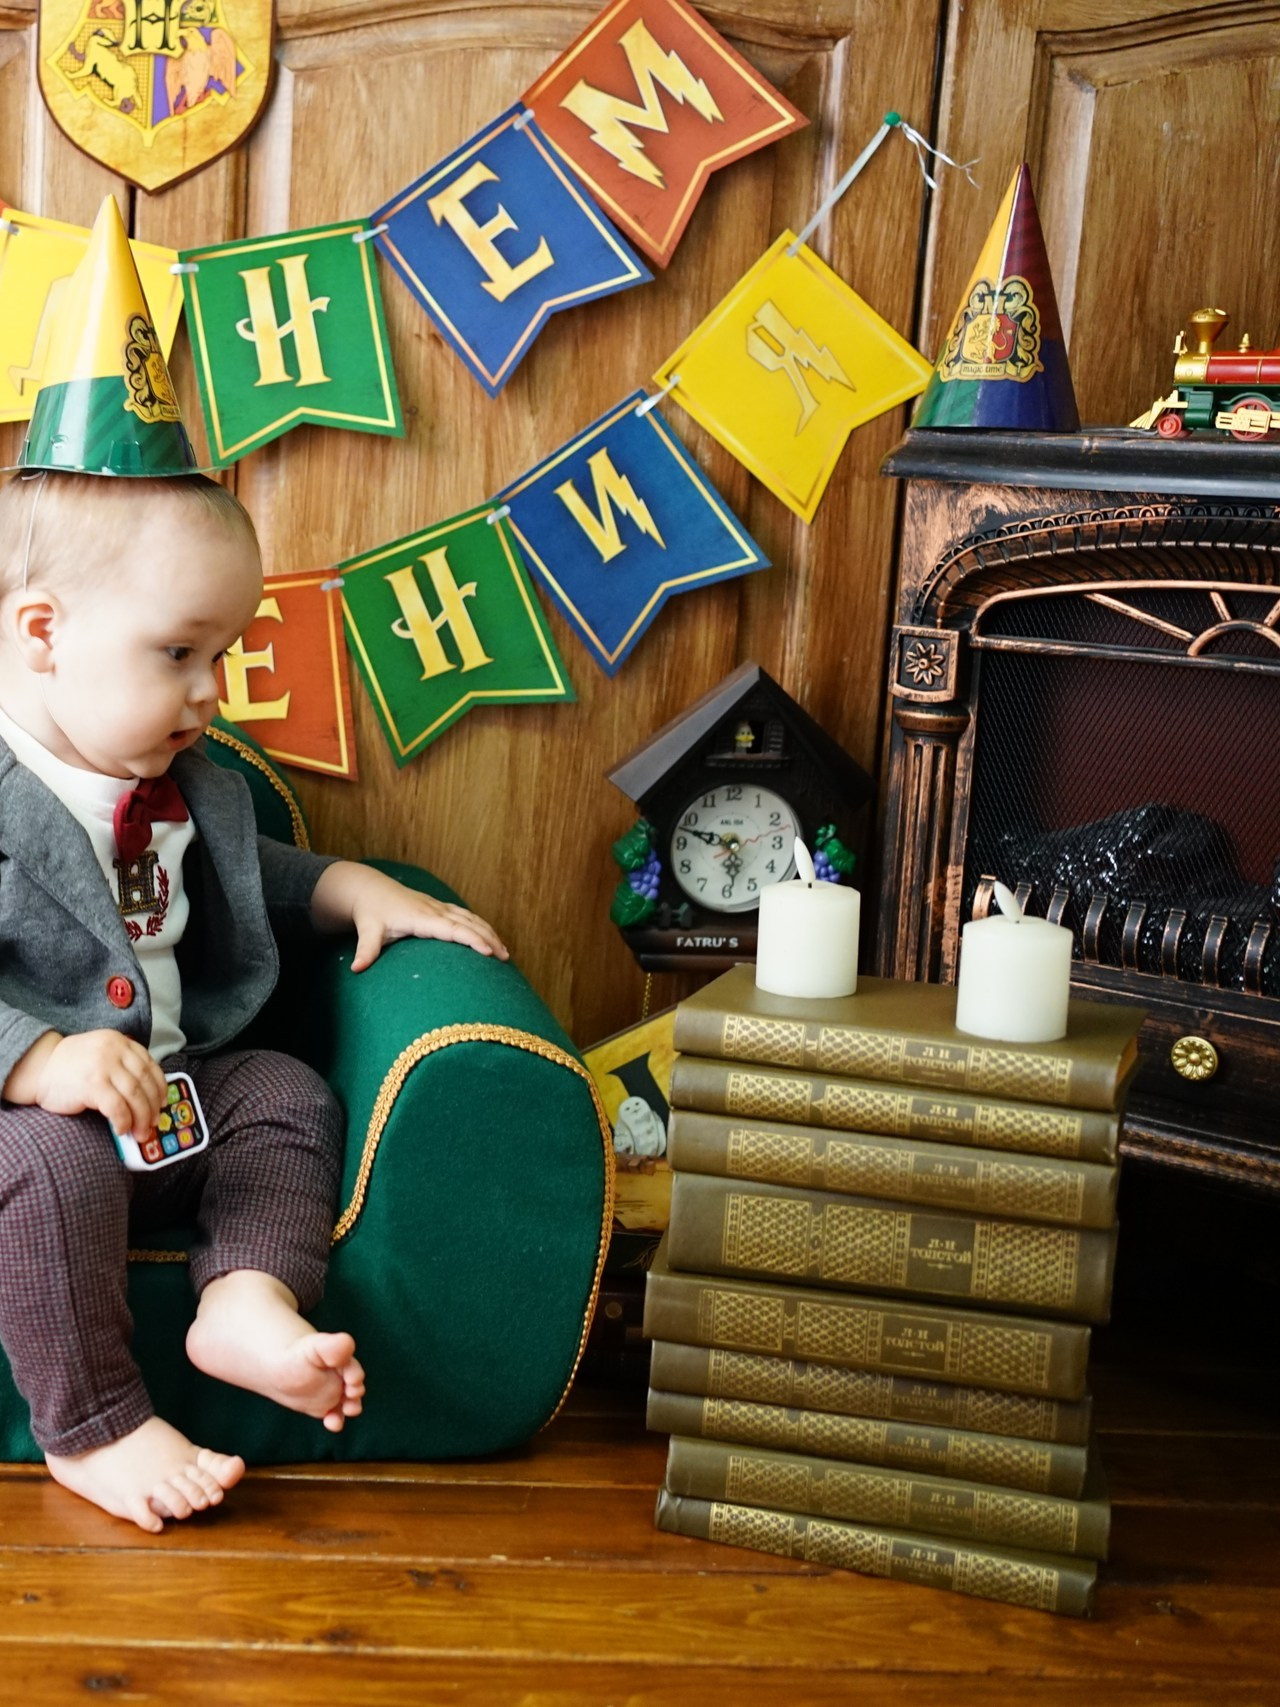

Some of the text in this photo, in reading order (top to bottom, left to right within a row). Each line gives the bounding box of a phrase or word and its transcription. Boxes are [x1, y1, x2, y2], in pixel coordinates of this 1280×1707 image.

[724, 786, 744, 801] 12
[754, 793, 762, 808] 1
[701, 795, 716, 808] 11
[683, 811, 699, 827] 10
[769, 811, 781, 826] 2
[676, 836, 688, 851] 9
[771, 835, 783, 850] 3
[679, 859, 692, 874] 8
[765, 859, 776, 874] 4
[696, 877, 708, 892] 7
[721, 883, 733, 899] 6
[746, 877, 757, 892] 5
[903, 1055, 965, 1073] ТОЛСТОЙ
[910, 1113, 973, 1131] ТОЛСТОЙ
[910, 1247, 972, 1264] ТОЛСТОЙ
[884, 1336, 945, 1352] ТОЛСТОЙ
[892, 1556, 954, 1576] ТОЛСТОЙ
